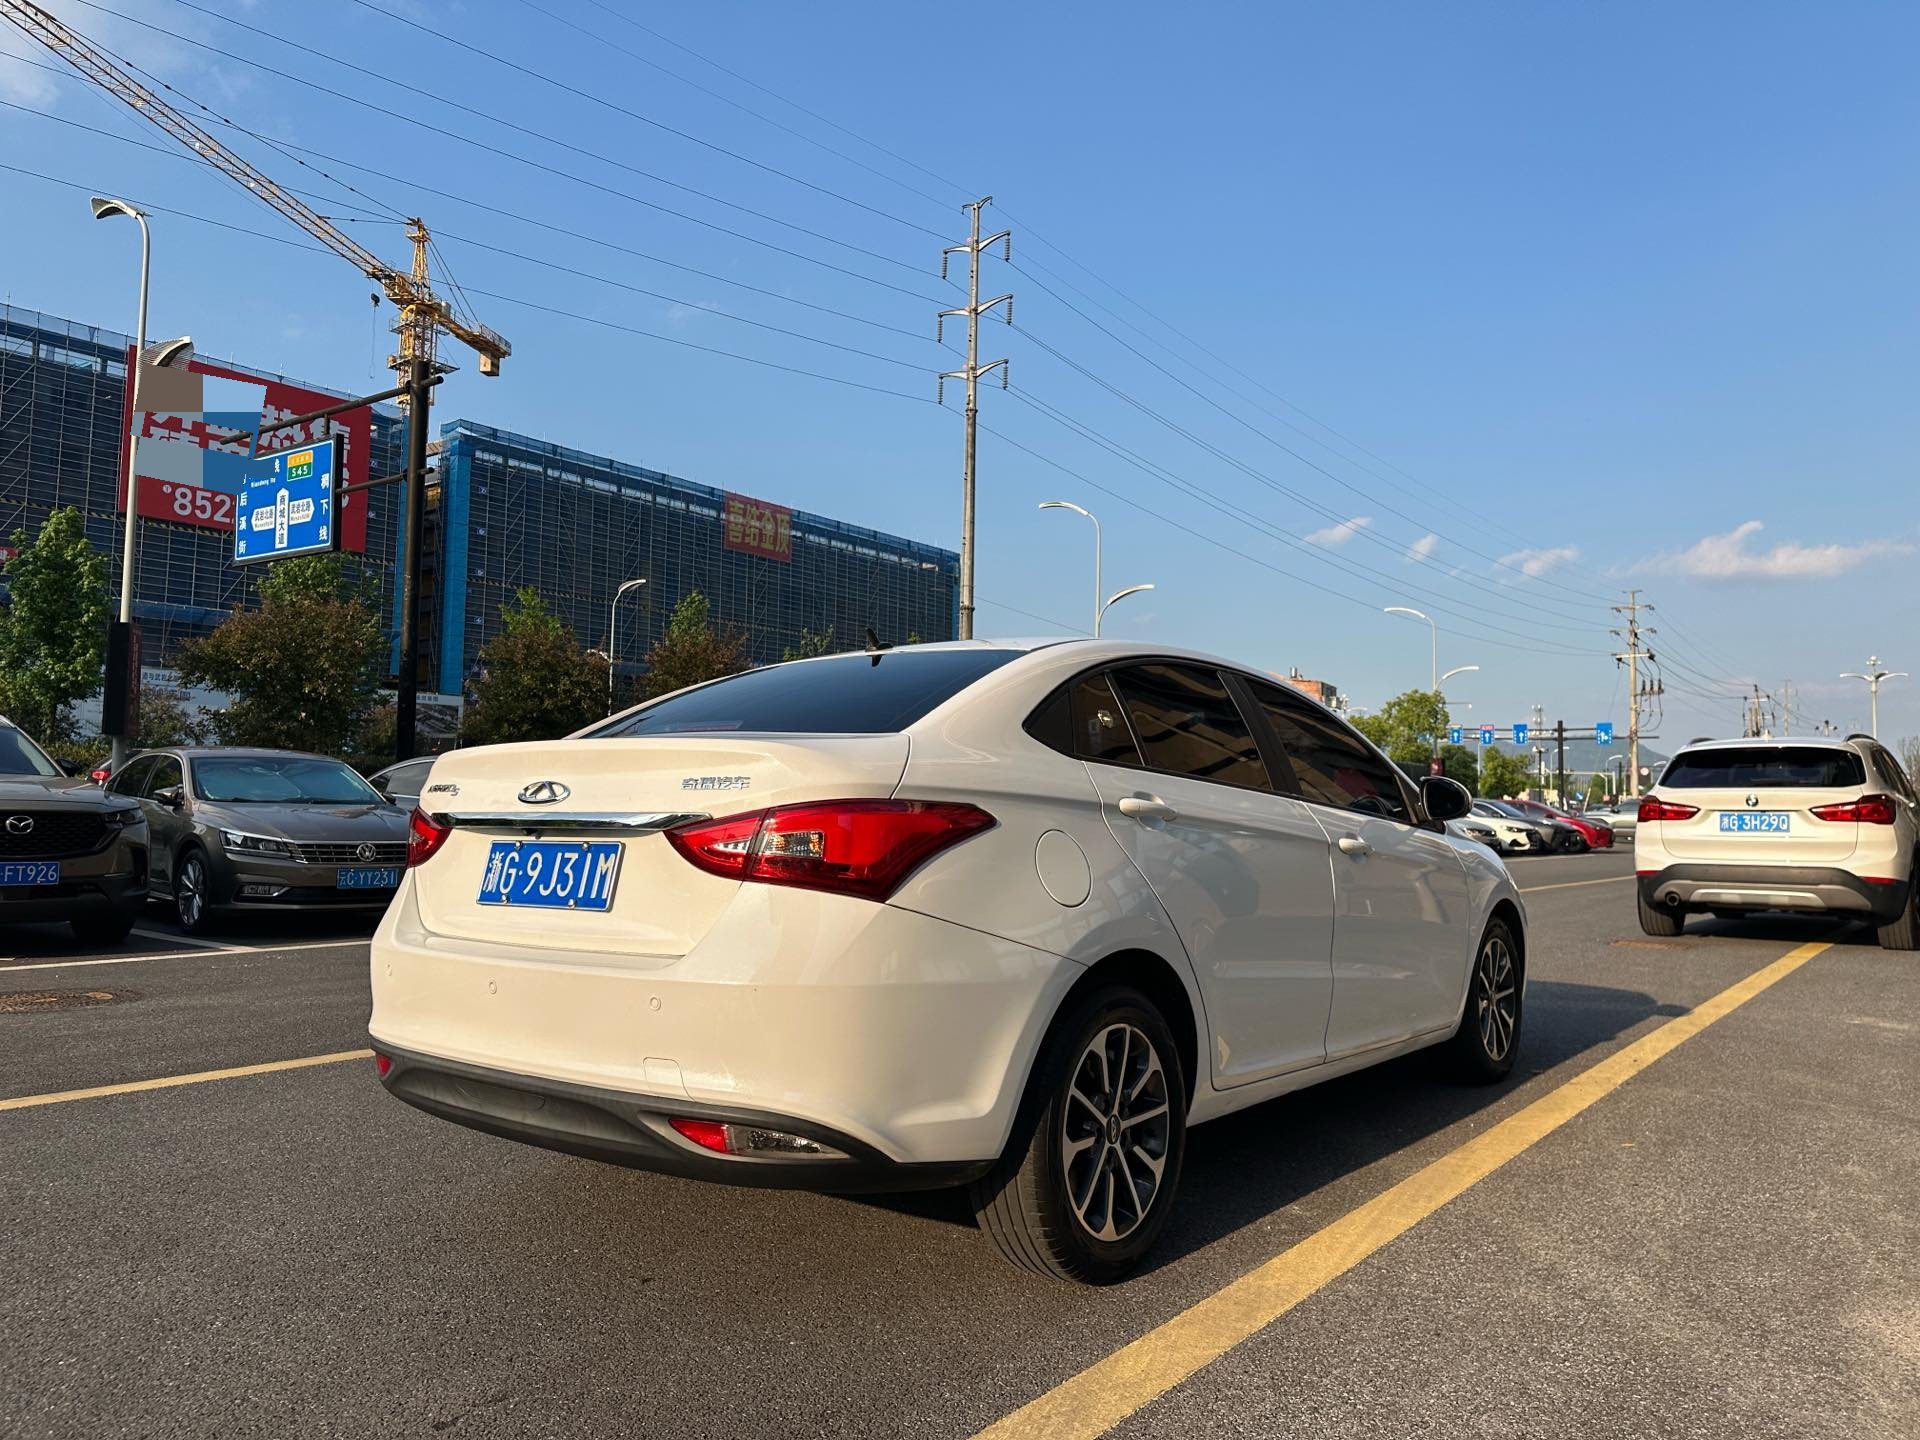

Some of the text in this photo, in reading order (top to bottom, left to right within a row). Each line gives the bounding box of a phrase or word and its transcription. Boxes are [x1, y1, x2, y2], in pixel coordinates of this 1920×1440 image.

[291, 465, 308, 477] S45
[173, 487, 235, 525] 852
[277, 494, 286, 545] 商城大道
[728, 500, 789, 554] 喜结金顶
[681, 776, 751, 791] 奇瑞汽车
